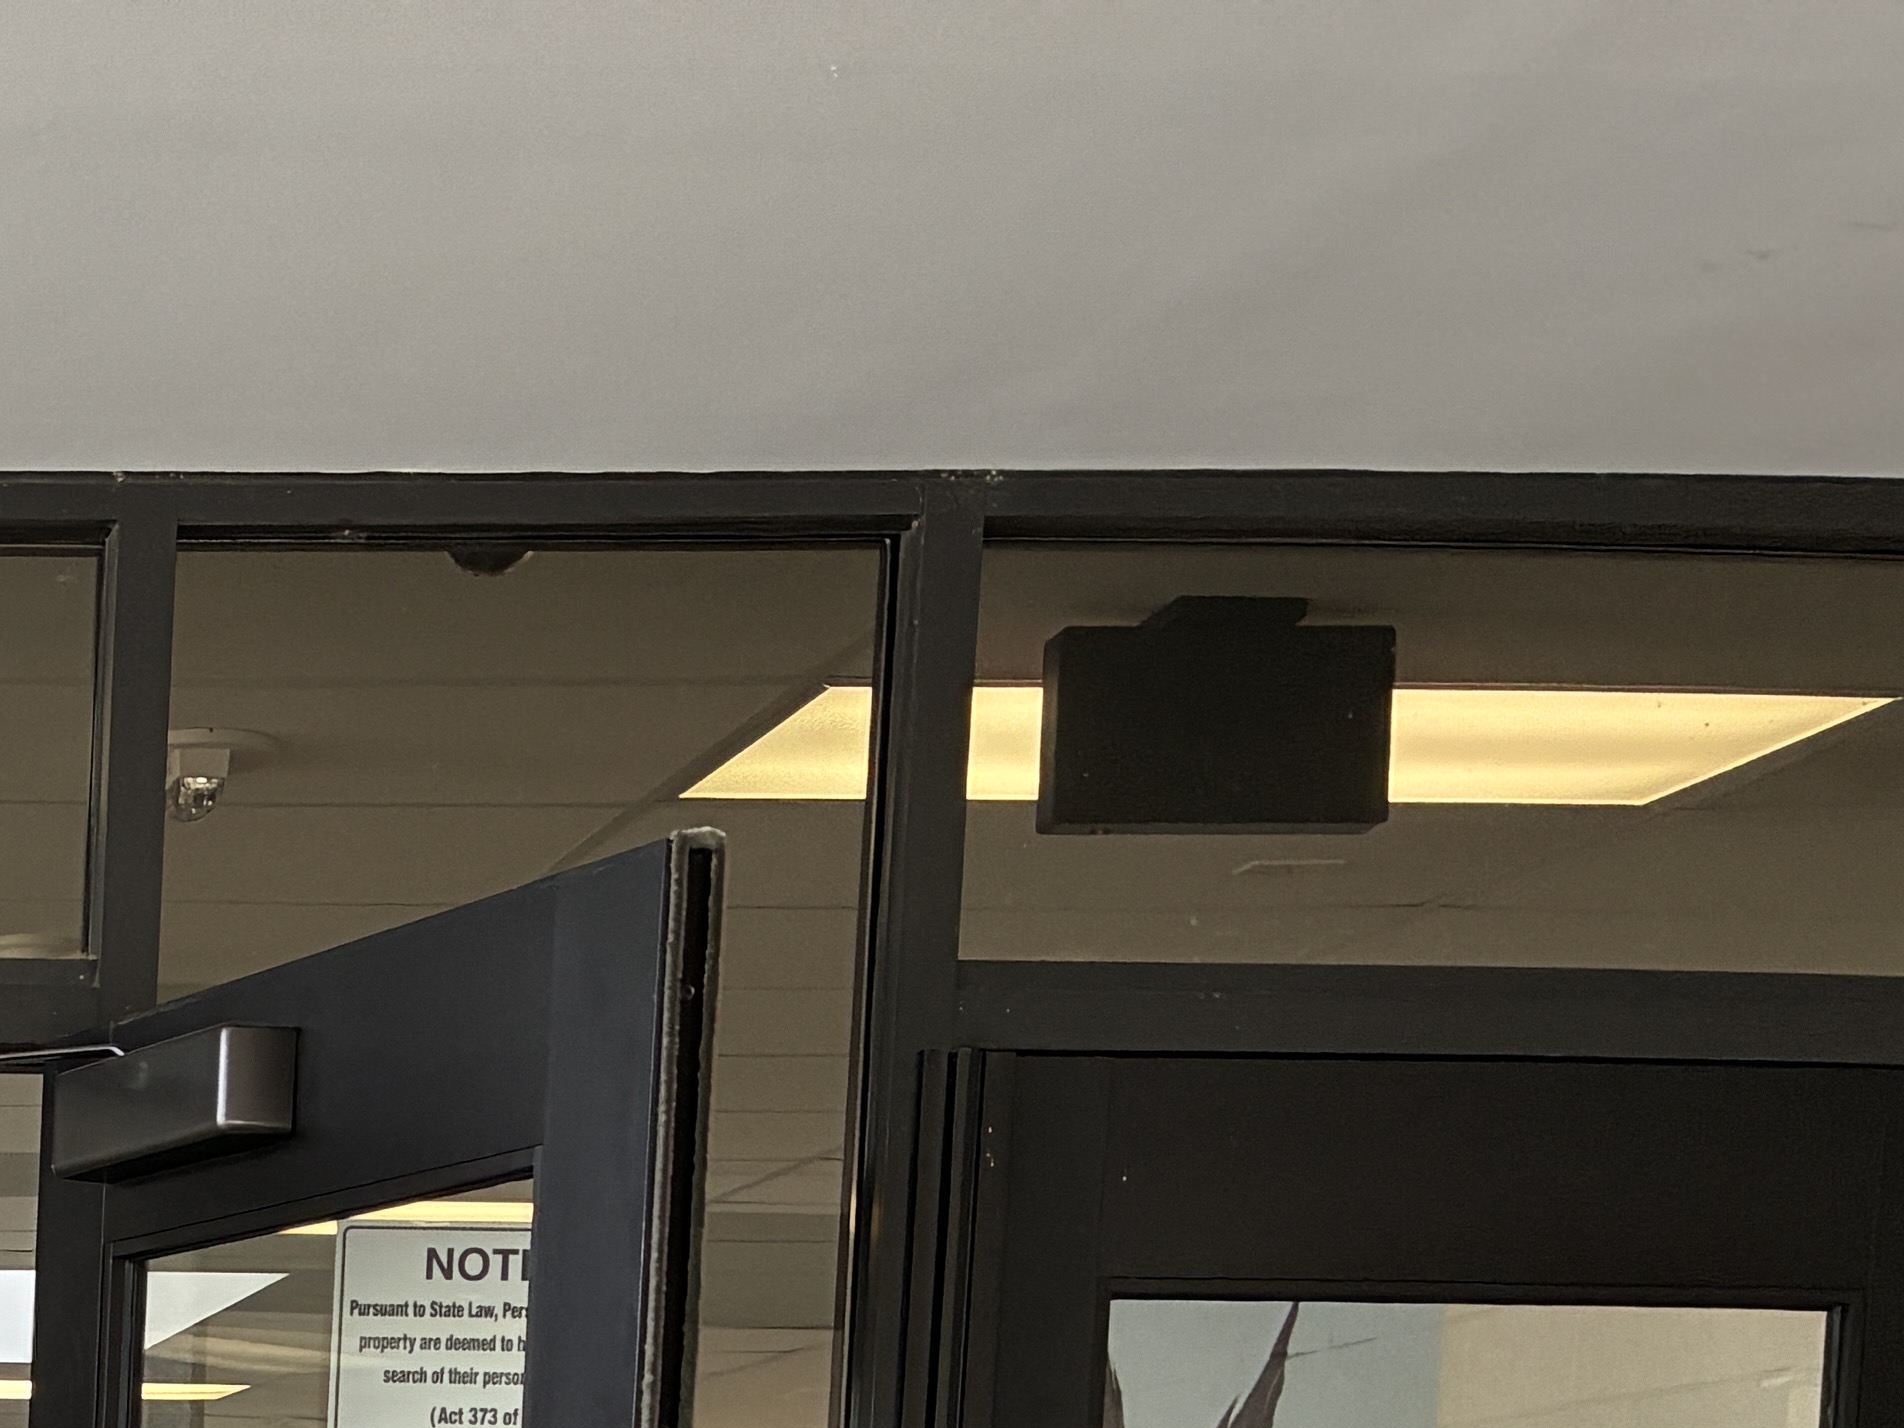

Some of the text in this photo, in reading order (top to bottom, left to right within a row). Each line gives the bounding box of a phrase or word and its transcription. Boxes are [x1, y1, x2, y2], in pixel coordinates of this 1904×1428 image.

[349, 1299, 409, 1318] Pursuant
[413, 1301, 426, 1318] to
[430, 1301, 464, 1318] State
[468, 1301, 498, 1322] Law,
[359, 1333, 416, 1354] property
[419, 1338, 441, 1351] are
[445, 1334, 496, 1351] deemed
[501, 1336, 513, 1351] to
[383, 1367, 427, 1384] search
[431, 1367, 445, 1384] of
[448, 1367, 479, 1385] their
[430, 1406, 519, 1428] (Act 373 of
